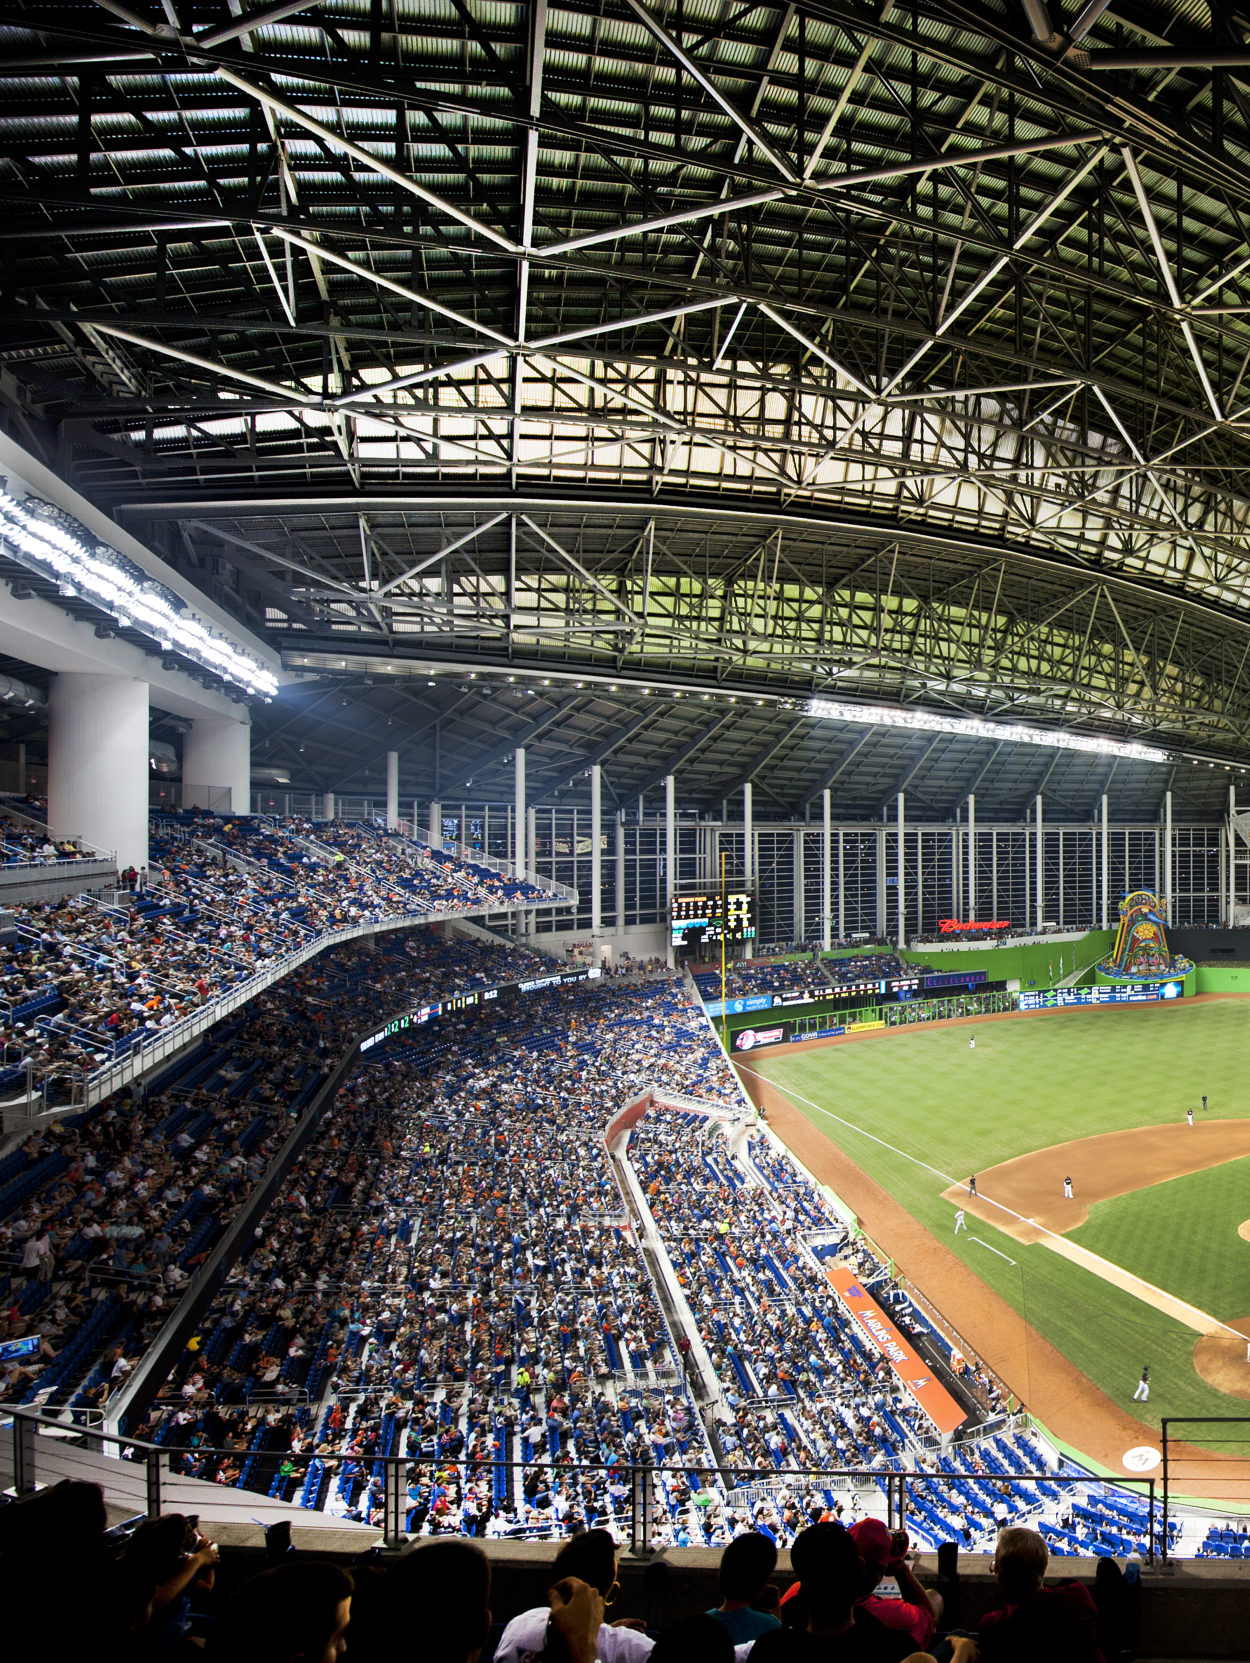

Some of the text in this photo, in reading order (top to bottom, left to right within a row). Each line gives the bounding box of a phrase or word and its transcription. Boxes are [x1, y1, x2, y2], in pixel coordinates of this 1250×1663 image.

[938, 918, 1010, 933] Budweiser
[563, 976, 577, 984] YOU
[745, 997, 767, 1006] simply
[393, 1019, 399, 1033] 2
[857, 1309, 909, 1366] MARLINS PARK
